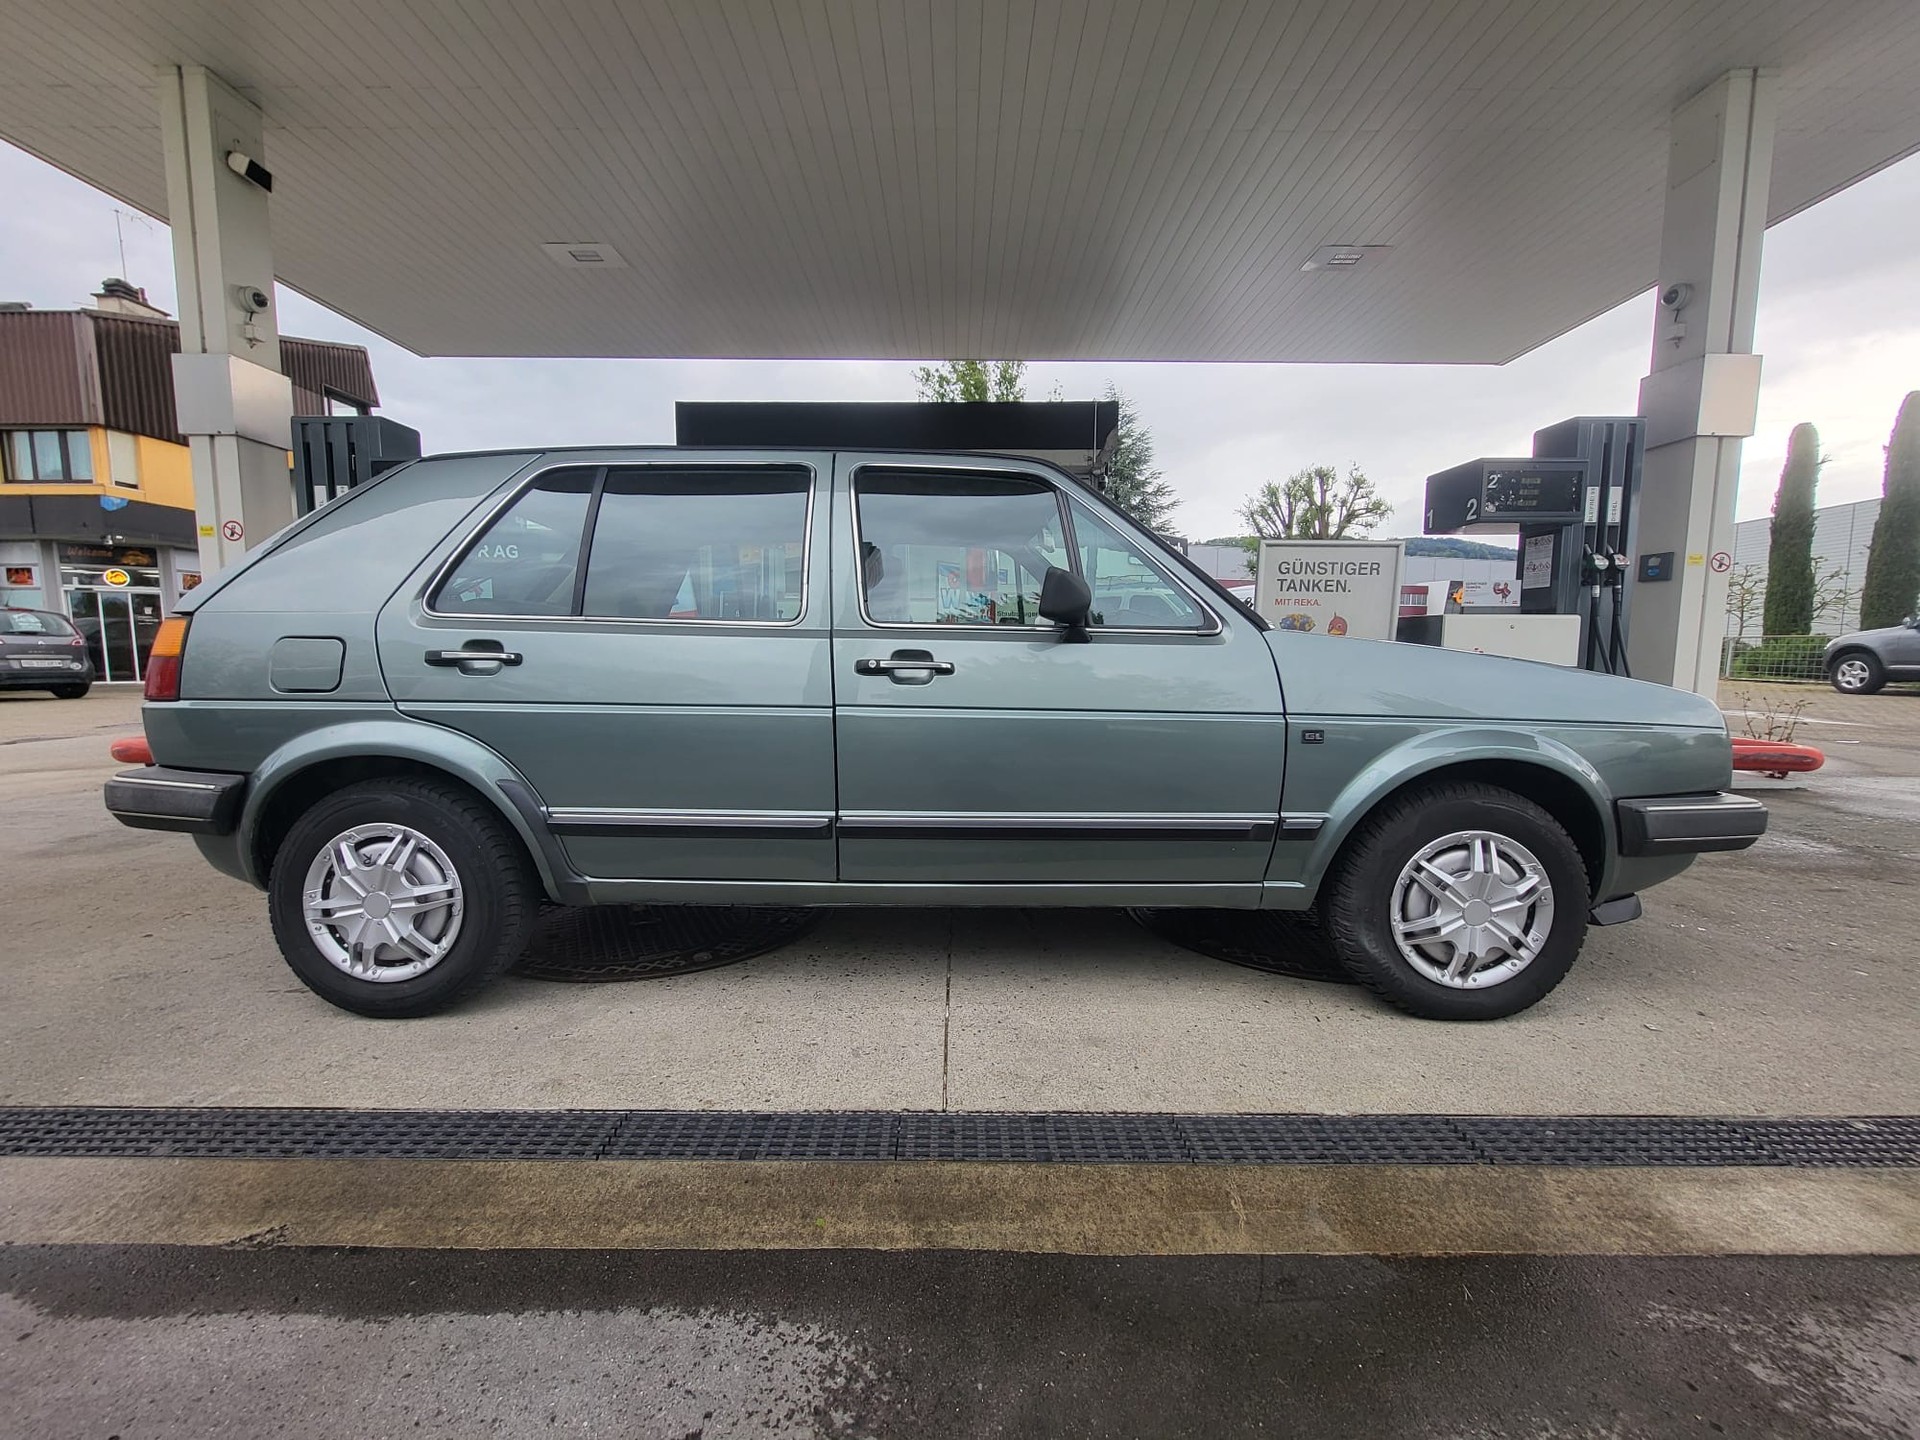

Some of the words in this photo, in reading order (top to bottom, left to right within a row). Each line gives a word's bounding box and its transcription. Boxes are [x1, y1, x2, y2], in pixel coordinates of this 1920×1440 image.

[1487, 474, 1499, 489] 2
[1466, 498, 1478, 521] 2
[1427, 509, 1434, 529] 1
[494, 545, 519, 559] AG
[1278, 558, 1381, 576] GÜNSTIGER
[1277, 579, 1351, 592] TANKEN.
